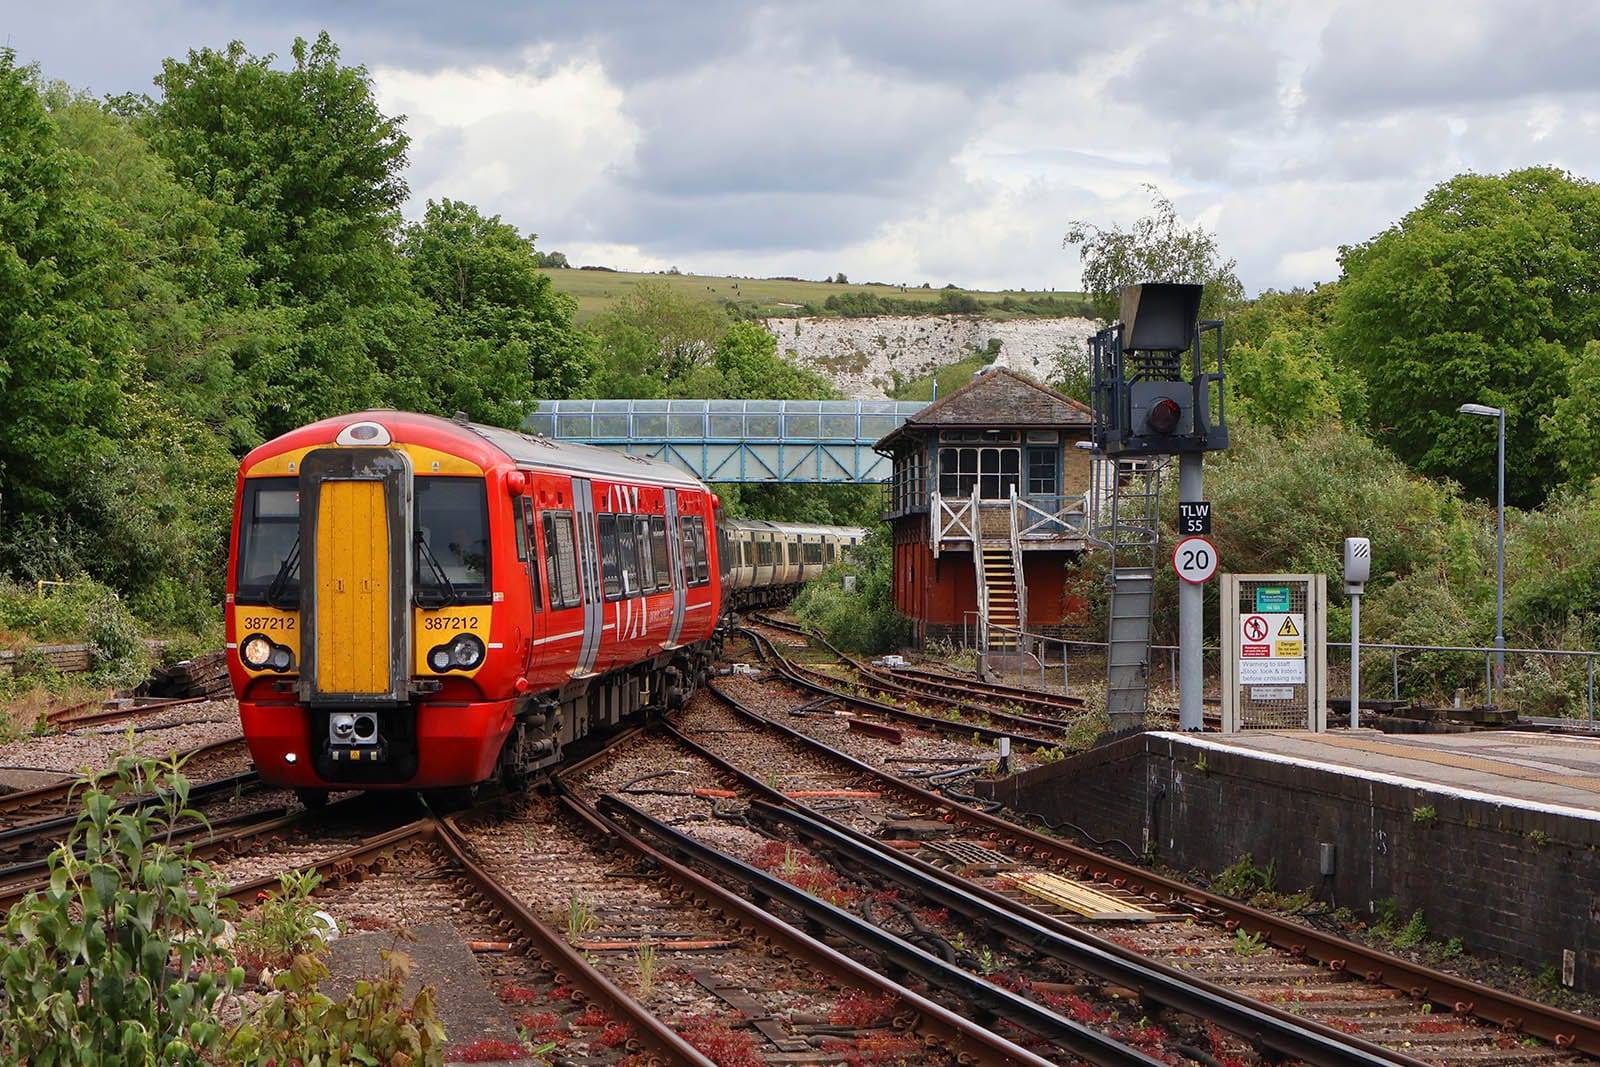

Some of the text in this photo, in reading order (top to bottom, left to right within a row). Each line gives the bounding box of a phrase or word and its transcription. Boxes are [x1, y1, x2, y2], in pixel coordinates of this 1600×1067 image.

[1180, 504, 1209, 517] TLW
[1187, 519, 1203, 532] 55
[1182, 550, 1209, 570] 20
[244, 617, 295, 630] 387212
[424, 616, 478, 630] 387212
